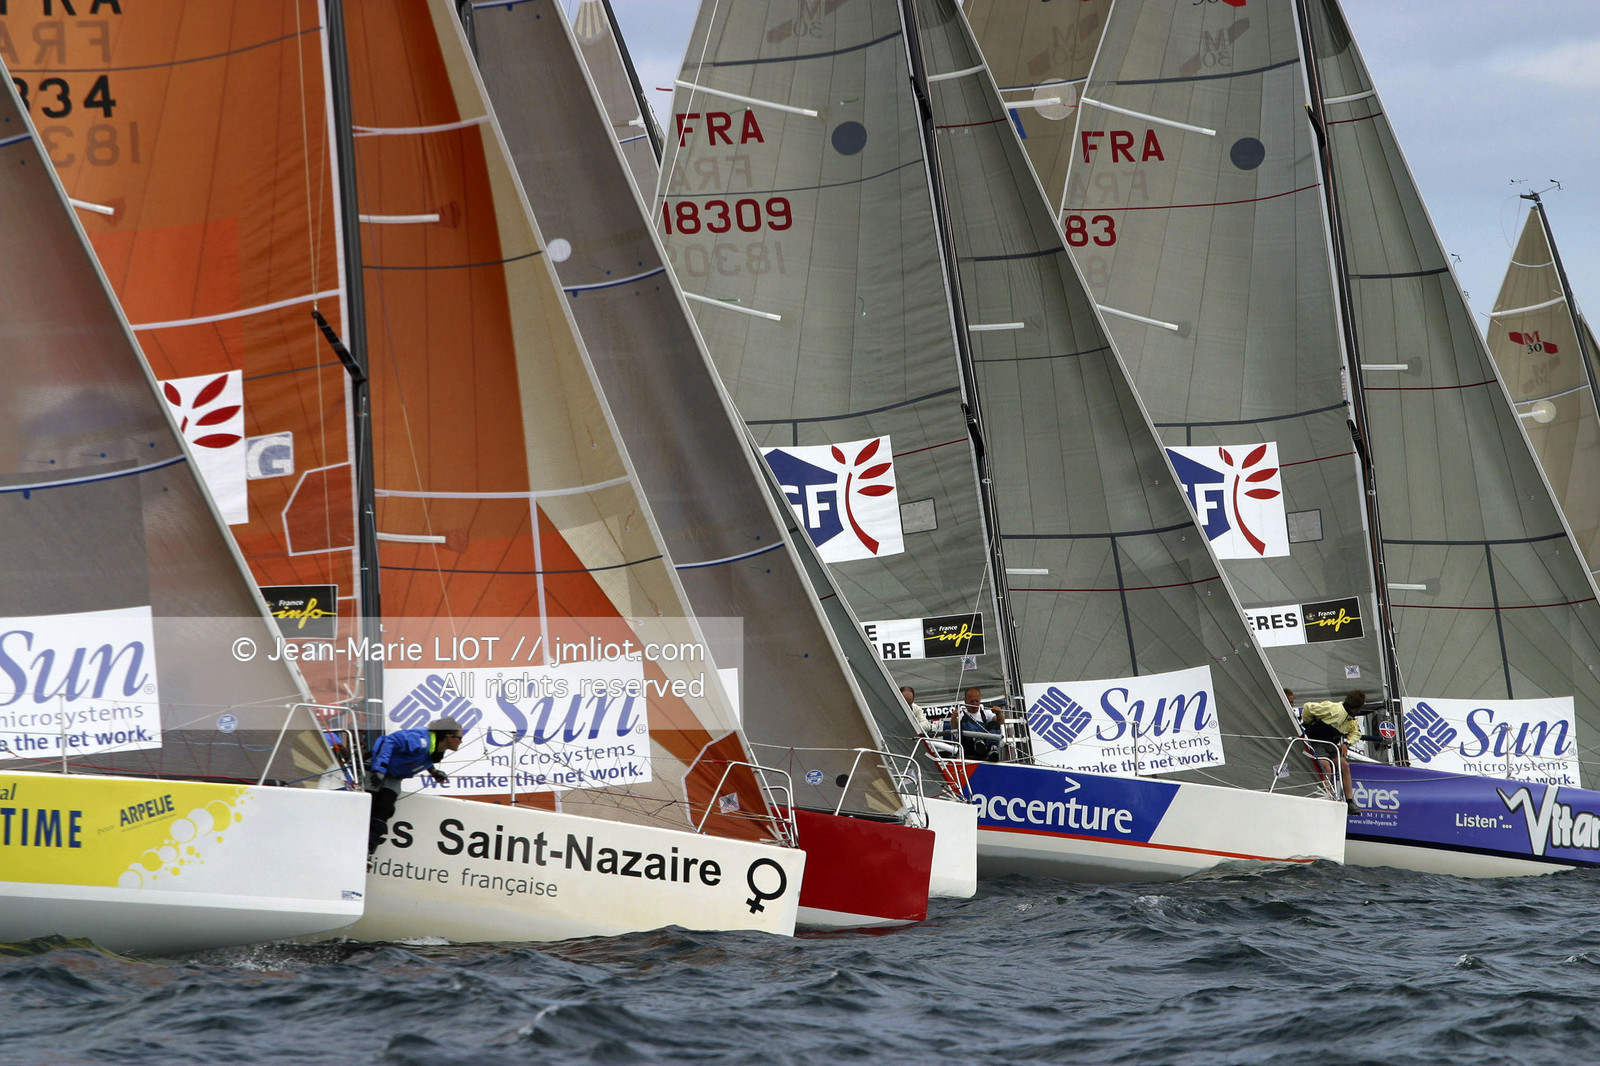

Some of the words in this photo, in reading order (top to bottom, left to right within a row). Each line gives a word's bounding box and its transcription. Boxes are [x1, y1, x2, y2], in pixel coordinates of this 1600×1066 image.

[676, 109, 765, 147] FRA
[1081, 129, 1165, 163] FRA
[662, 197, 793, 235] 18309
[1065, 215, 1117, 247] 83
[276, 598, 327, 629] info
[1314, 608, 1353, 632] info
[935, 623, 975, 647] info
[0, 630, 149, 706] Sun
[486, 678, 640, 748] Sun
[1096, 687, 1212, 741] Sun
[14, 733, 48, 750] the
[56, 731, 89, 748] net
[95, 725, 153, 745] work.
[1101, 735, 1211, 757] microsystems
[1459, 708, 1572, 758] Sun
[457, 772, 508, 788] make
[515, 772, 546, 786] the
[553, 768, 585, 784] net
[590, 761, 644, 781] work.
[1150, 755, 1174, 768] net
[1178, 749, 1219, 766] work.
[1463, 760, 1569, 775] microsystems
[1, 807, 82, 848] TIME
[120, 794, 175, 827] ARPEIJE
[972, 793, 1134, 834] accenture
[437, 818, 722, 886] Saint-Nazaire
[367, 853, 450, 884] idature
[461, 867, 559, 897] française
